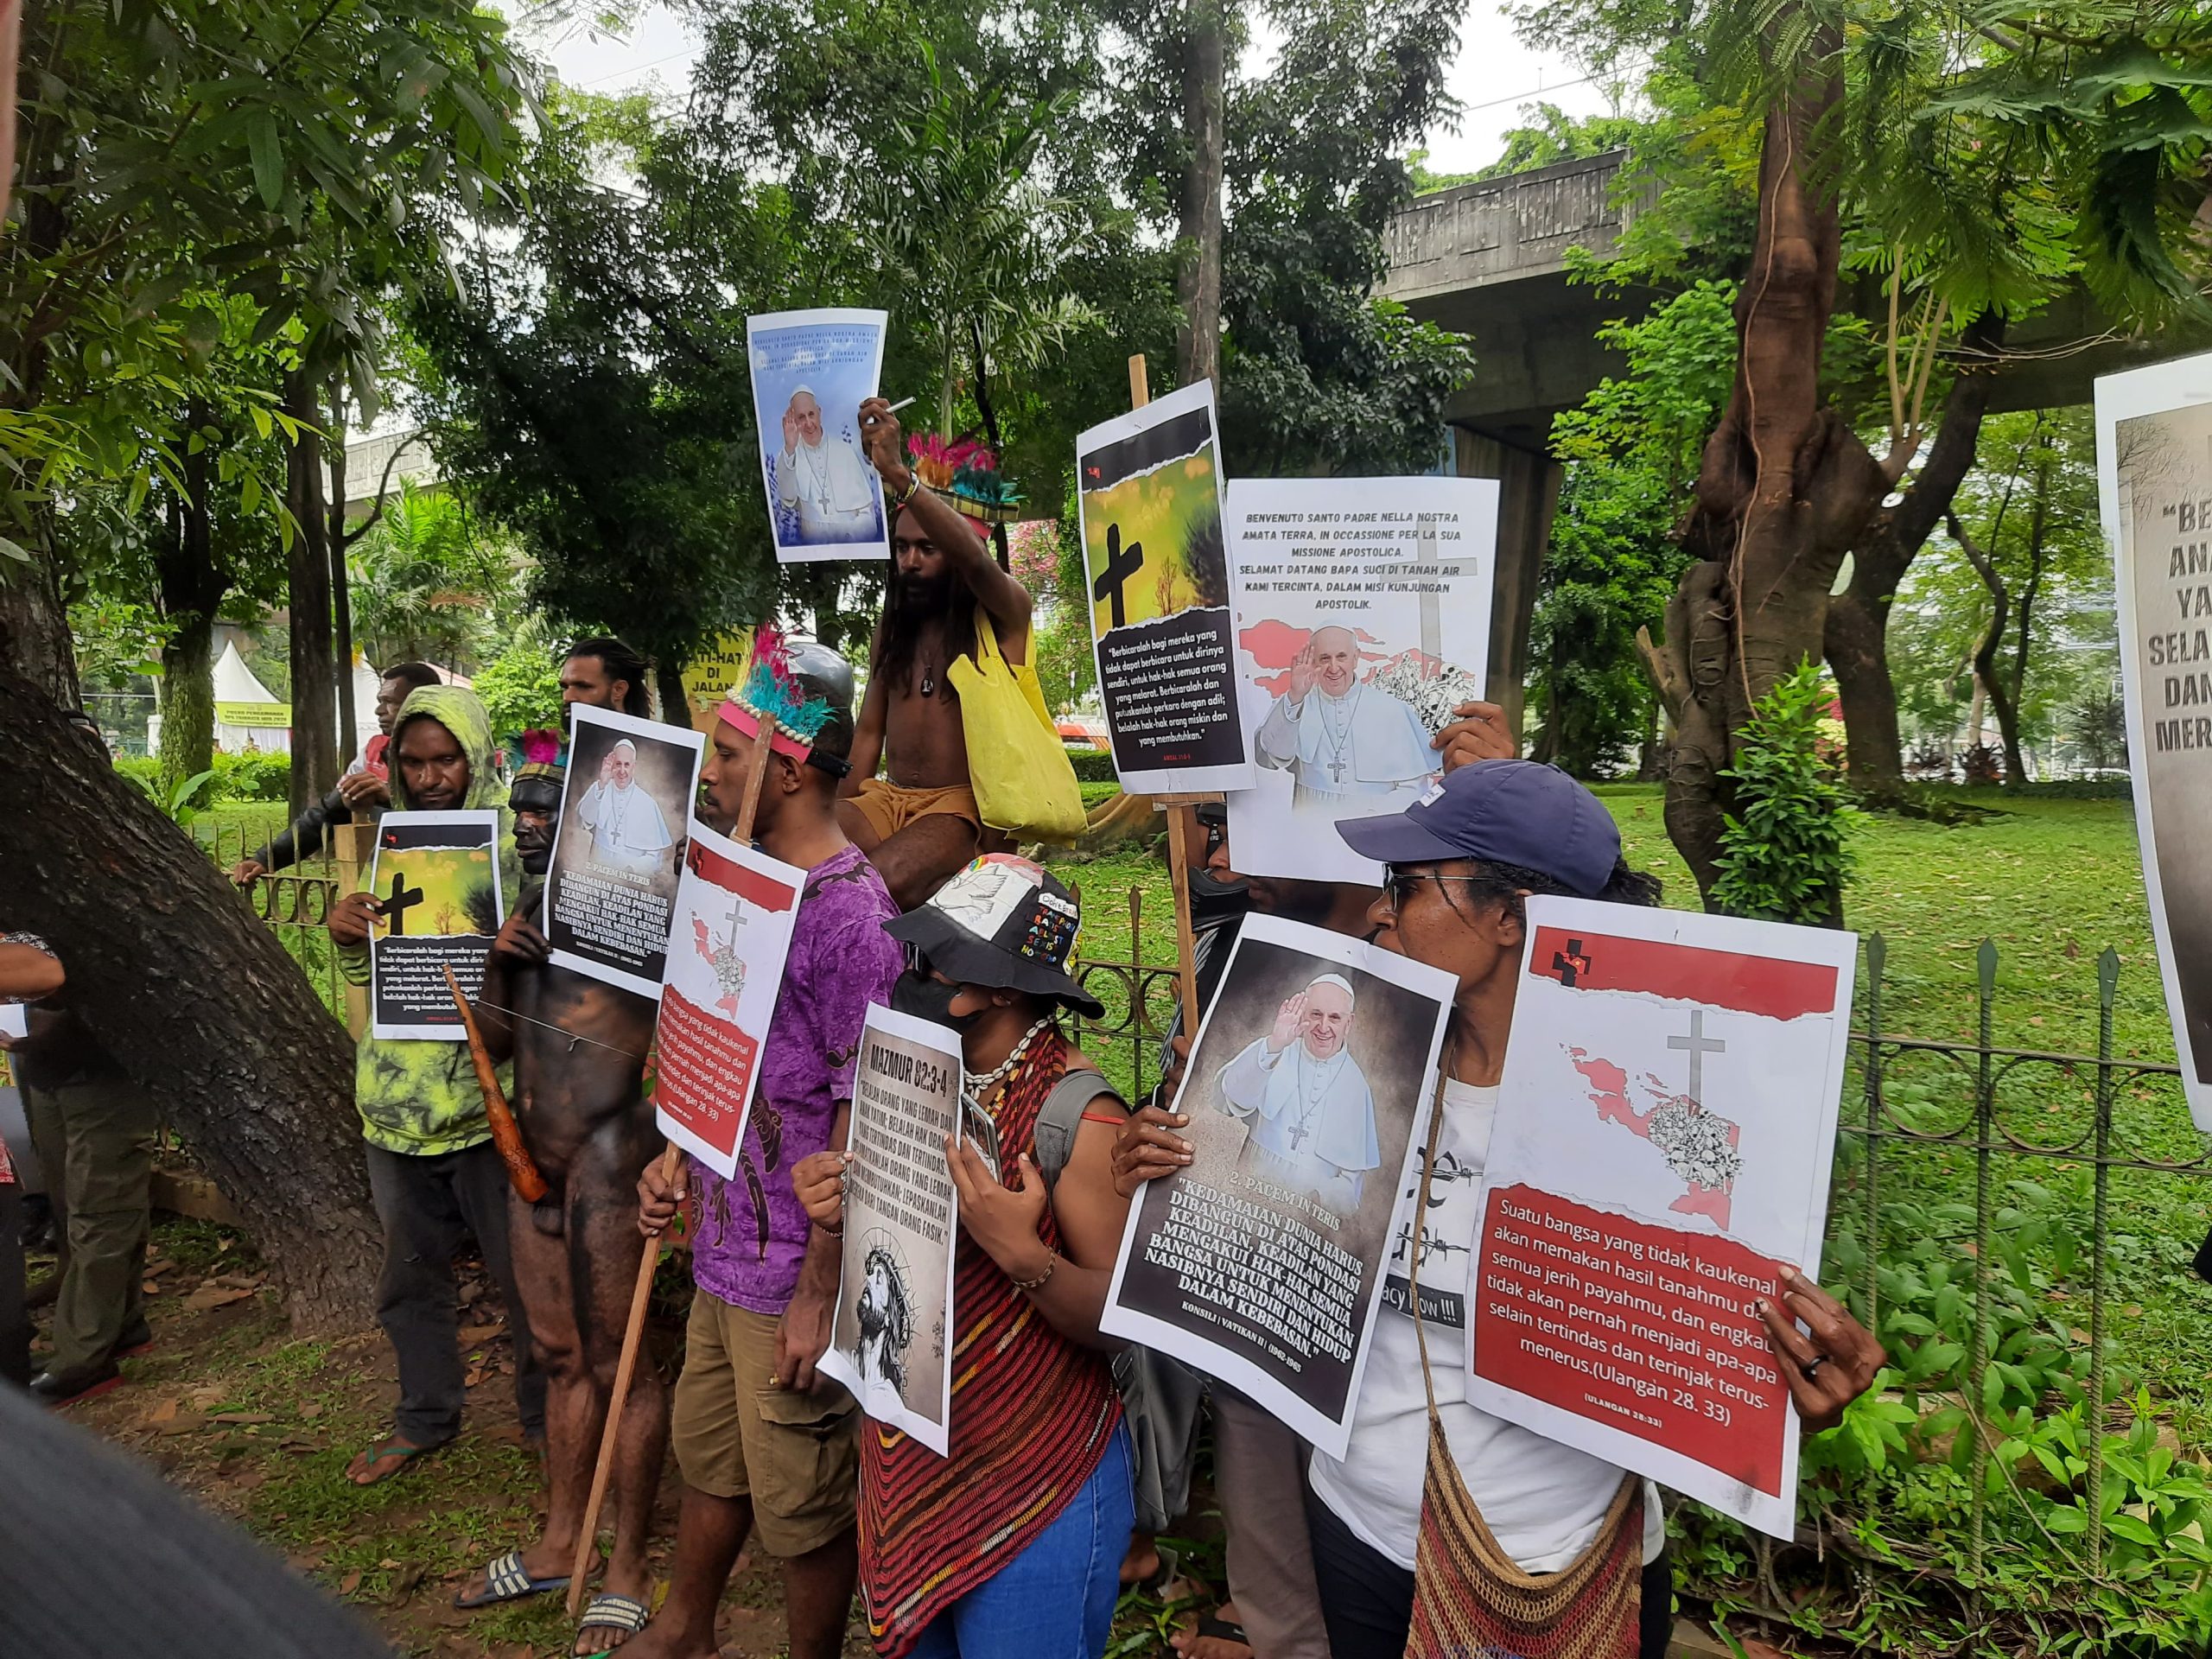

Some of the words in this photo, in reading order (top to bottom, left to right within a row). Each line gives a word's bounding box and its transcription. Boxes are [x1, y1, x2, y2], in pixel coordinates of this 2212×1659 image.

[1243, 531, 1276, 540] AMATA
[1281, 531, 1316, 540] TERRA,
[1320, 531, 1329, 540] IN
[1333, 531, 1395, 540] OCCASSIONE
[1399, 531, 1418, 539] PER
[1423, 531, 1436, 540] LA
[1440, 531, 1460, 540] SUA
[1246, 513, 1304, 524] BENVENUTO
[1307, 513, 1339, 523] SANTO
[1344, 513, 1376, 523] PADRE
[1382, 513, 1413, 522] NELLA
[1417, 513, 1458, 523] NOSTRA
[1240, 565, 1283, 574] SELAMAT
[1287, 565, 1326, 575] DATANG
[1331, 565, 1358, 575] BAPA
[1363, 565, 1384, 575] SUCI
[1389, 566, 1397, 575] DI
[1402, 566, 1438, 575] TANAH
[1442, 567, 1459, 575] AIR
[1292, 548, 1335, 557] MISSIONE
[1339, 548, 1403, 556] APOSTOLICA.
[1245, 582, 1268, 591] KAMI
[1273, 582, 1323, 592] TERCINTA,
[1326, 582, 1361, 592] DALAM
[1365, 582, 1384, 592] MISI
[1389, 582, 1449, 592] KUNJUNGAN
[1315, 601, 1371, 609] APOSTOLIK.
[1105, 664, 1122, 674] tidak
[1122, 661, 1140, 672] dapat
[1141, 655, 1172, 667] berbicara
[1173, 649, 1194, 661] untuk
[1196, 645, 1224, 658] dirinya
[1151, 638, 1166, 651] bagi
[1168, 632, 1195, 646] mereka
[1197, 630, 1217, 644] yang
[692, 682, 733, 692] JALAN
[708, 667, 719, 678] DI
[1107, 678, 1130, 689] sendiri,
[1130, 672, 1147, 685] untuk
[1148, 668, 1176, 682] hak-hak
[1177, 666, 1200, 677] semua
[1202, 663, 1226, 674] orang
[1116, 693, 1132, 705] yang
[1133, 689, 1159, 701] melarat.
[1160, 681, 1202, 696] Berbicaralah
[1204, 679, 1219, 690] dan
[1116, 704, 1153, 721] putuskanlah
[1154, 699, 1179, 715] perkara
[1180, 697, 1206, 711] dengan
[1208, 693, 1225, 706] adil;
[1117, 721, 1141, 733] belalah
[1141, 716, 1168, 730] hak-hak
[1168, 715, 1187, 727] orang
[1188, 712, 1211, 724] miskin
[1211, 711, 1227, 721] dan
[1139, 734, 1155, 747] yang
[560, 878, 600, 898] DIBANGUN
[611, 895, 632, 906] ATAS
[632, 899, 668, 917] PONDASI
[613, 885, 639, 899] DUNIA
[640, 890, 668, 907] HARUS
[689, 1014, 702, 1031] yang
[703, 1023, 718, 1037] tidak
[718, 1032, 749, 1055] kaukenal
[870, 1044, 912, 1084] MAZMUR
[914, 1059, 947, 1097] 82:3-4
[880, 1090, 899, 1111] ORANG
[901, 1097, 918, 1118] YANG
[918, 1104, 939, 1128] LEMAH
[940, 1113, 953, 1133] DAN
[869, 1126, 897, 1154] TERTINDAS
[898, 1141, 912, 1160] DAN
[912, 1147, 946, 1176] TERTINDAS.
[1230, 1172, 1243, 1185] 2.
[1246, 1177, 1296, 1205] PACEM
[1298, 1198, 1310, 1211] IN
[1312, 1205, 1340, 1232] TERIS
[1170, 1191, 1253, 1232] DIBANGUN
[1256, 1224, 1274, 1243] DI
[1279, 1235, 1310, 1262] ATAS
[1310, 1250, 1362, 1294] PONDASI
[1179, 1177, 1281, 1227] "KEDAMAIAN
[1286, 1217, 1322, 1249] DUNIA
[1324, 1241, 1363, 1275] HARUS
[1168, 1206, 1253, 1252] KEADILAN,
[1256, 1241, 1322, 1283] KEADILAN
[1322, 1278, 1355, 1310] YANG
[1500, 1199, 1541, 1225] Suatu
[1545, 1216, 1599, 1243] bangsa
[1604, 1234, 1643, 1261] yang
[1648, 1244, 1690, 1270] tidak
[1695, 1257, 1777, 1297] kaukenal
[1161, 1222, 1250, 1262] MENGAKUI
[1251, 1255, 1311, 1298] HAK-HAK
[1310, 1289, 1351, 1328] SEMUA
[1494, 1225, 1529, 1247] akan
[1533, 1239, 1611, 1274] memakan
[1615, 1261, 1654, 1285] hasil
[1658, 1275, 1738, 1313] tanahmu
[1144, 1249, 1225, 1287] NASIBNYA
[1227, 1281, 1286, 1317] SENDIRI
[1287, 1311, 1310, 1336] DAN
[1311, 1325, 1351, 1363] HIDUP
[1149, 1234, 1213, 1267] BANGSA
[1216, 1258, 1271, 1294] UNTUK
[1273, 1286, 1355, 1348] MENENTUKAN
[1492, 1252, 1541, 1278] semua
[1544, 1266, 1580, 1291] jerih
[1585, 1281, 1667, 1320] payahmu,
[1672, 1308, 1705, 1331] dan
[1178, 1275, 1234, 1310] DALAM
[1237, 1300, 1320, 1358] KEBEBASAN."
[1486, 1274, 1524, 1299] tidak
[1527, 1288, 1564, 1311] akan
[1568, 1302, 1626, 1333] pernah
[1631, 1325, 1700, 1357] menjadi
[1706, 1348, 1777, 1385] apa-apa
[1182, 1301, 1217, 1323] KONSILI
[1222, 1317, 1258, 1344] VATIKAN
[1268, 1343, 1301, 1374] (1962-1965
[1489, 1301, 1533, 1327] selain
[1536, 1318, 1607, 1352] tertindas
[1611, 1342, 1643, 1365] dan
[1648, 1353, 1714, 1389] terinjak
[1719, 1377, 1770, 1410] terus-
[1520, 1338, 1668, 1402] menerus.(Ulangan
[1673, 1389, 1698, 1413] 28.
[1703, 1400, 1731, 1427] 33)
[1585, 1393, 1630, 1415] (ULANGAN
[1632, 1411, 1662, 1428] 28:33)
